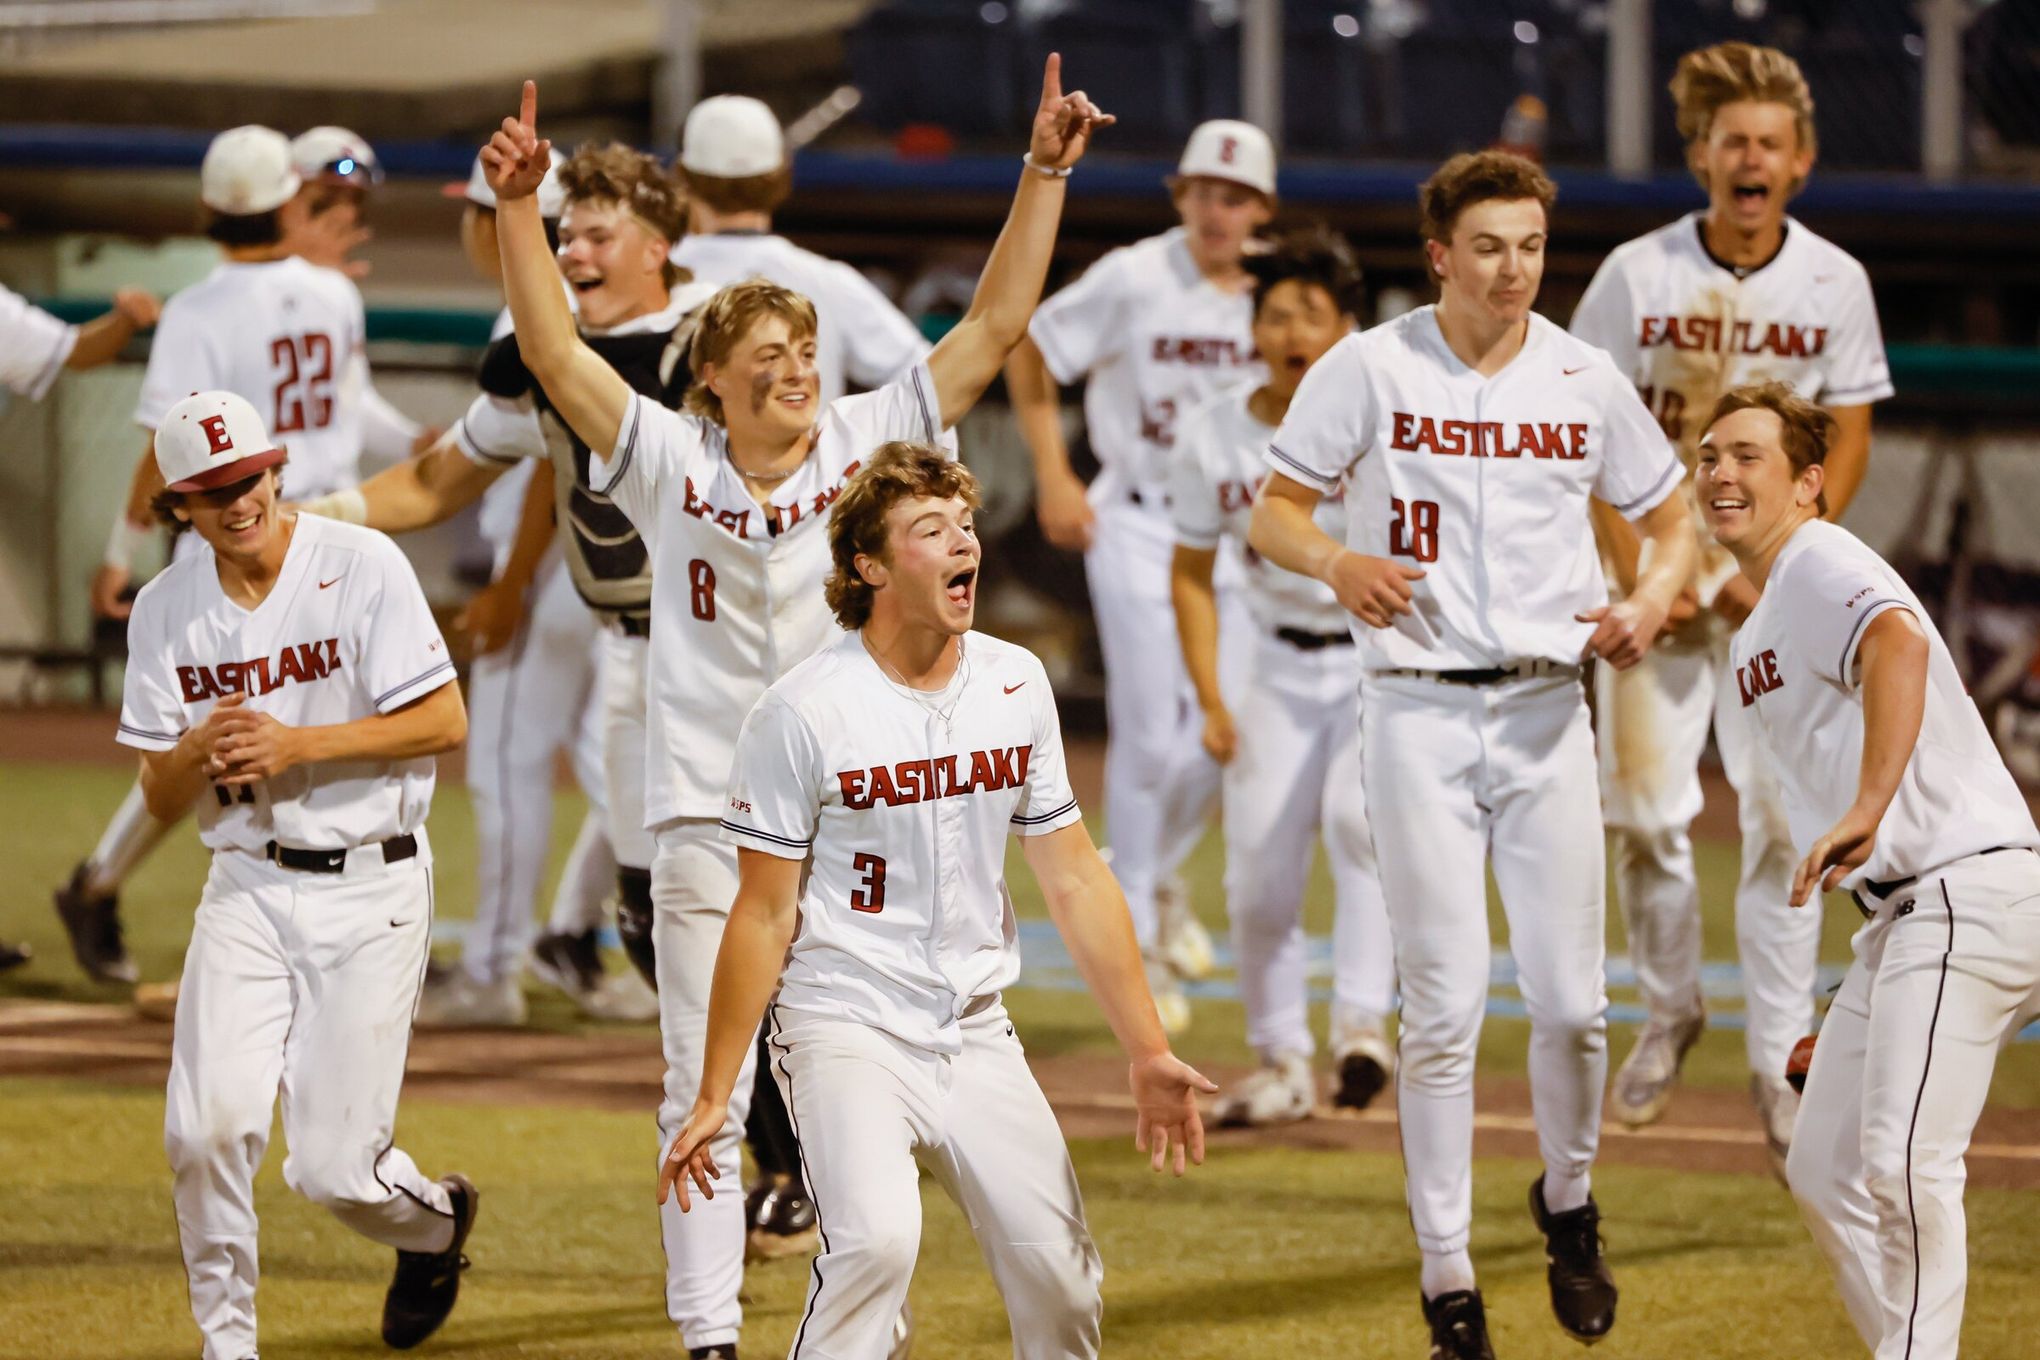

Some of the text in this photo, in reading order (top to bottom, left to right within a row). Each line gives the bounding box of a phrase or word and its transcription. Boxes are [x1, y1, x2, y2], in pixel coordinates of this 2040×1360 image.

[271, 332, 333, 435] 22
[198, 414, 234, 456] E
[1390, 412, 1588, 460] EASTLAKE
[1390, 495, 1439, 562] 28
[688, 558, 716, 622] 8
[1736, 648, 1785, 708] LKE
[730, 796, 752, 814] PS
[850, 852, 887, 914] 3
